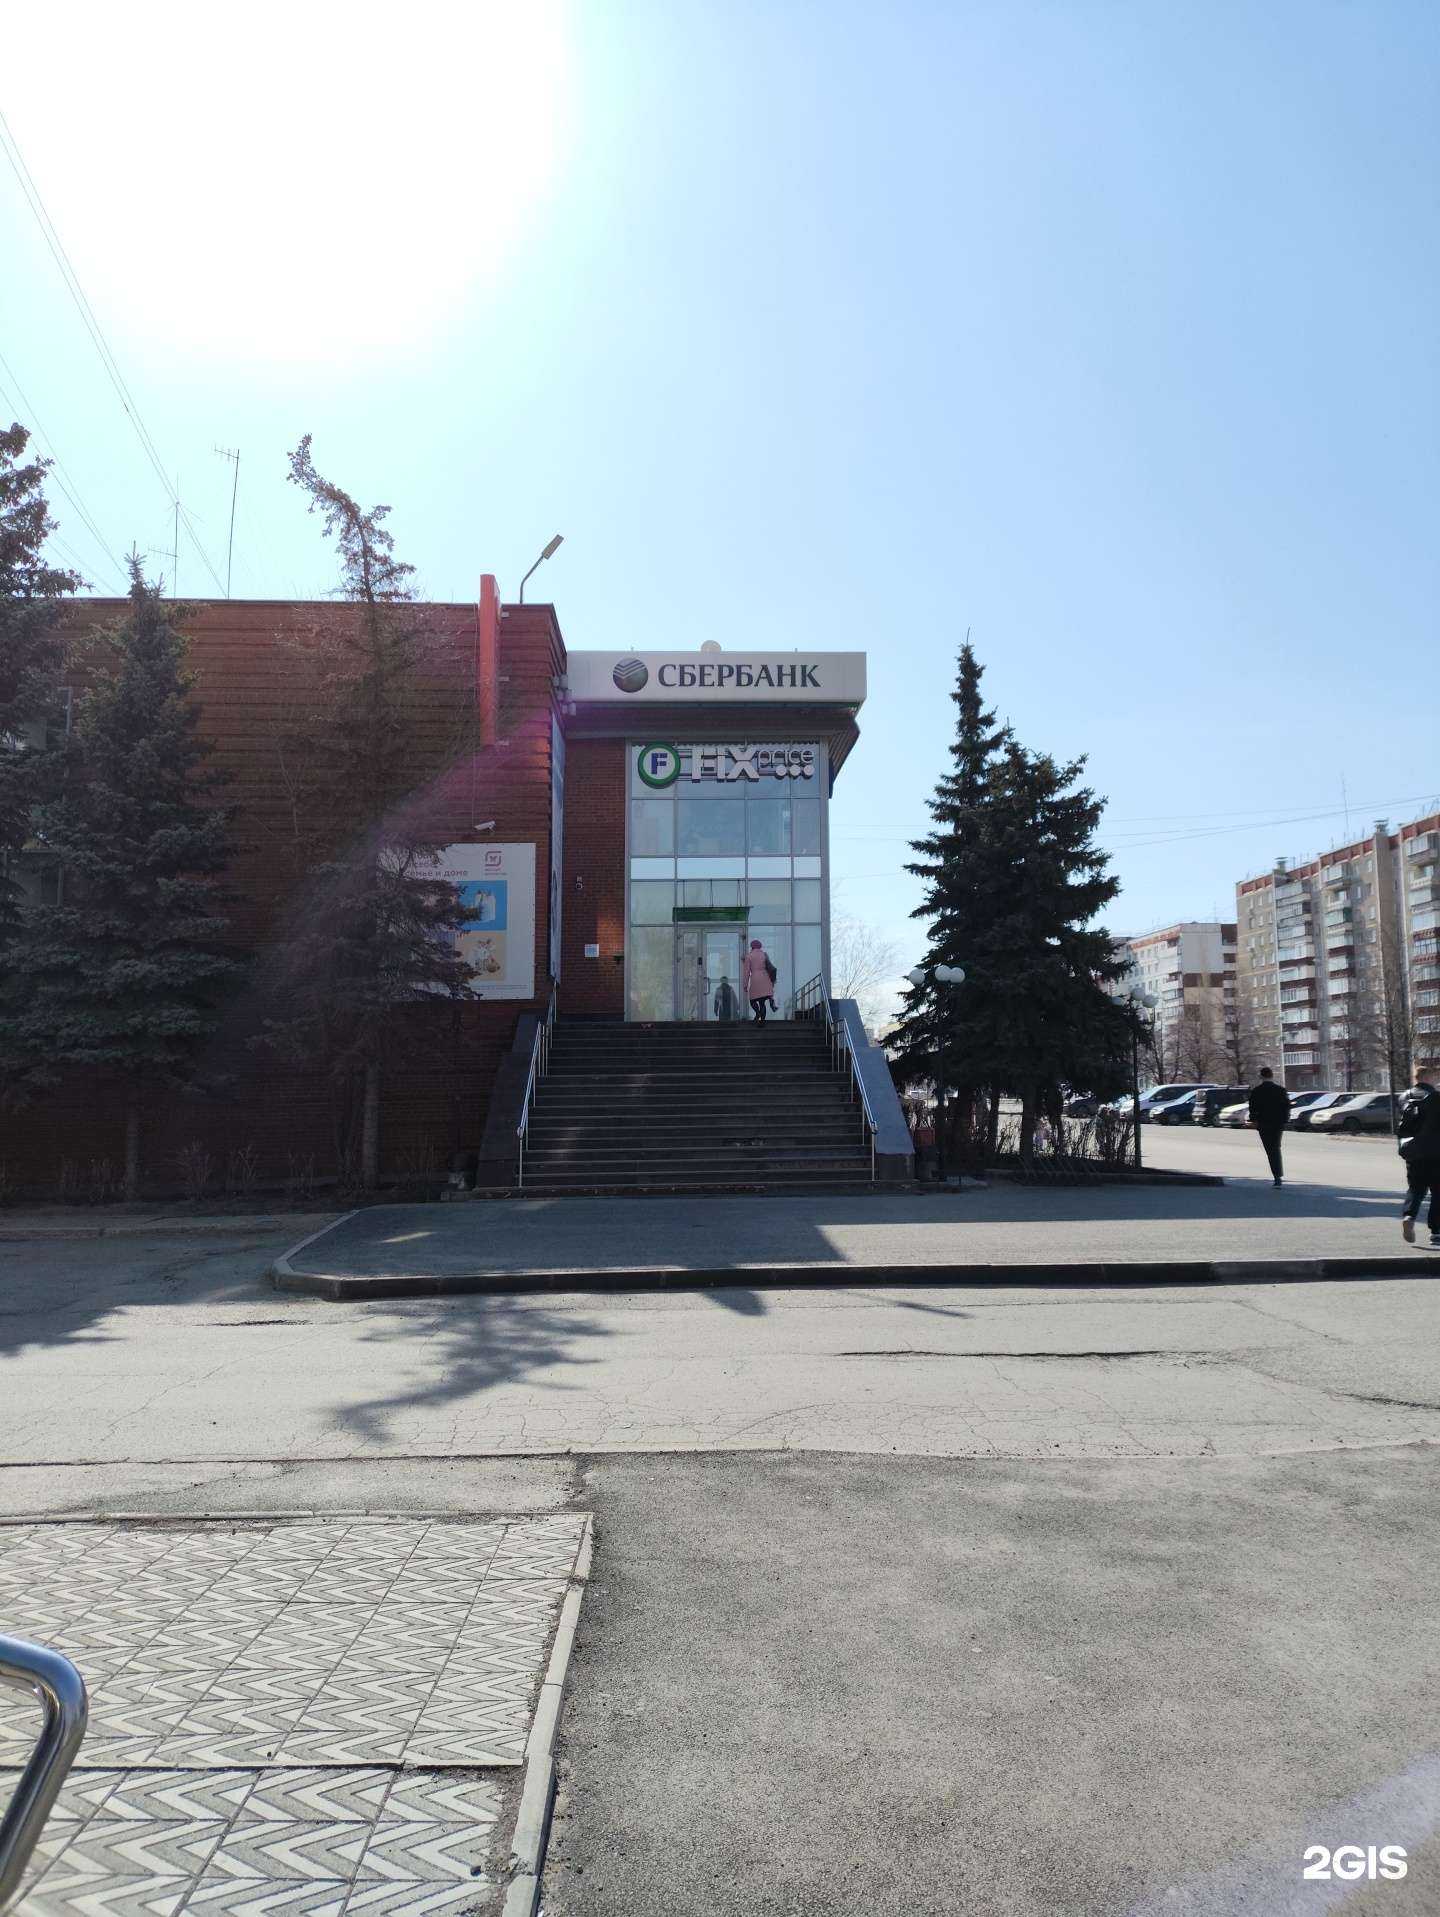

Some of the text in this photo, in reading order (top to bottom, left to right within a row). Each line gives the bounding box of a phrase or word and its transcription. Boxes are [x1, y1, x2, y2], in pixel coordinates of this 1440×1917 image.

[657, 664, 822, 688] СБЕРБАНК
[651, 753, 668, 775] F
[691, 747, 814, 782] FIX price
